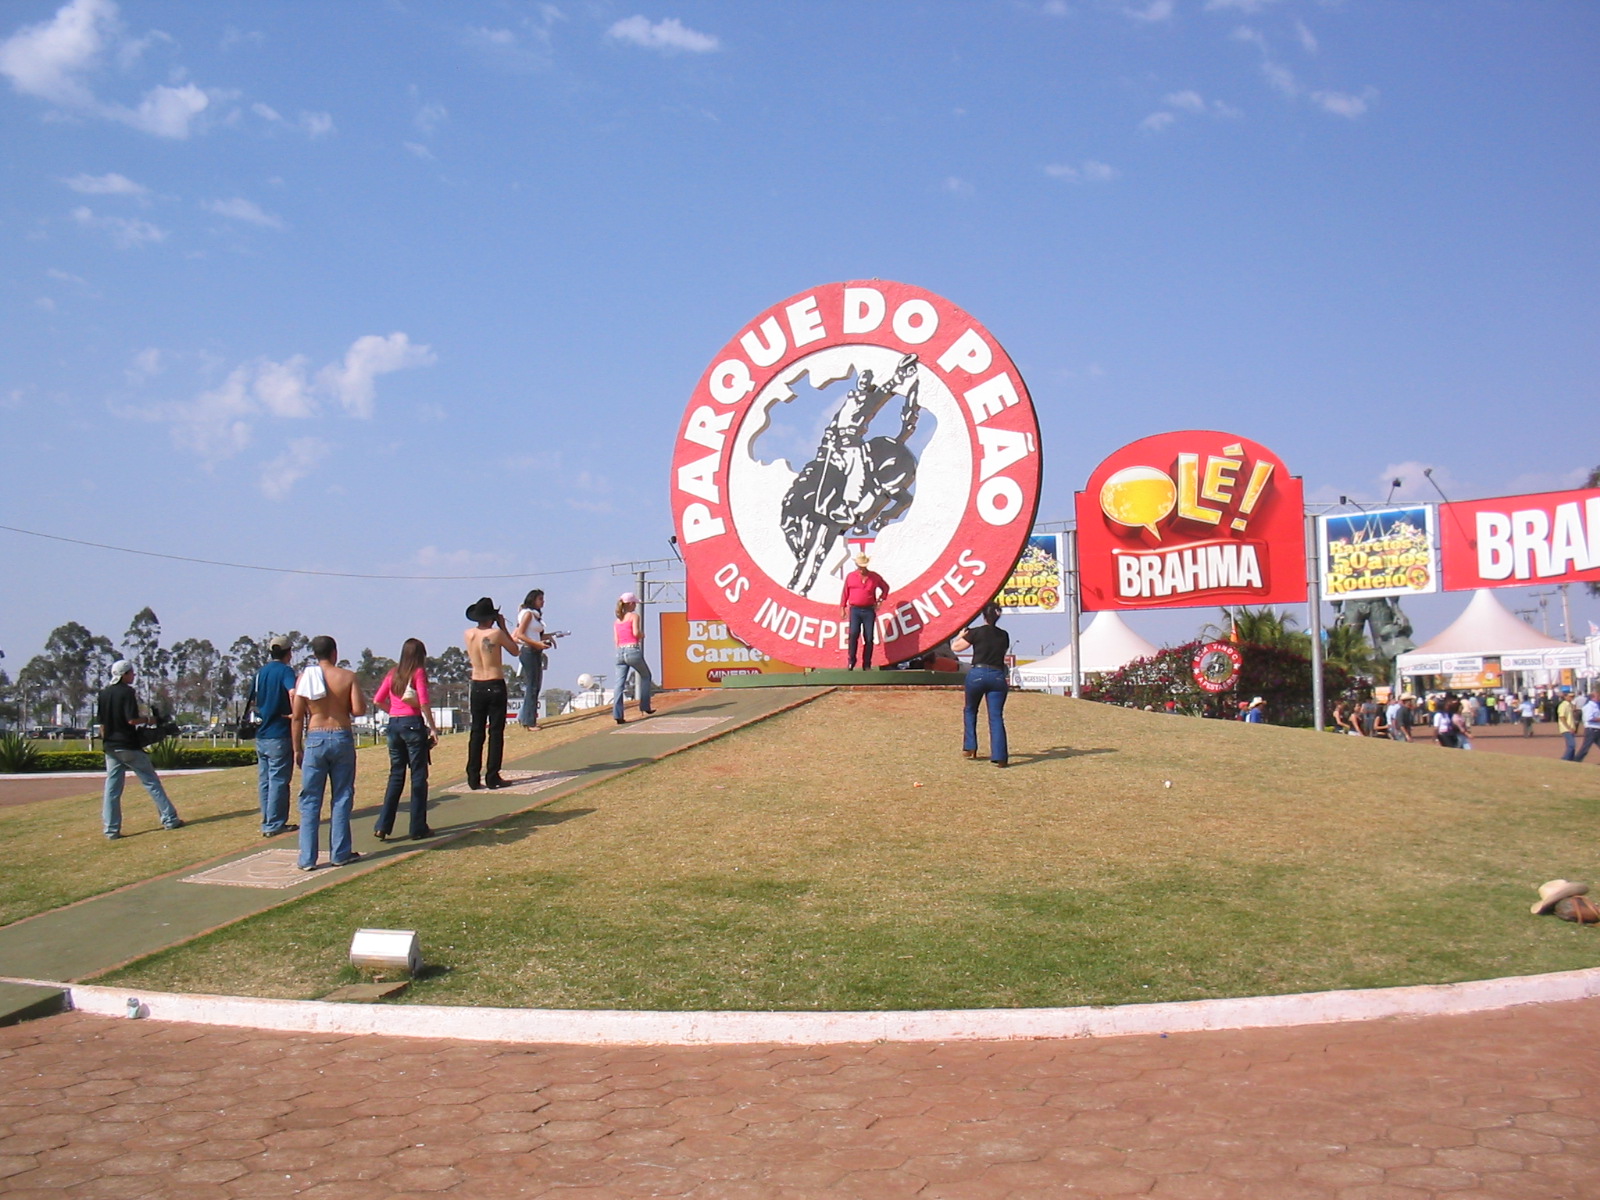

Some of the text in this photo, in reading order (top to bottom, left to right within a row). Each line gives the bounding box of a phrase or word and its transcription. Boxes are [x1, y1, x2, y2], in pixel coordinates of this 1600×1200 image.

[678, 287, 1036, 545] PARQUE DO PEÃO
[1329, 538, 1412, 556] Barretos
[1117, 543, 1264, 599] BRAHMA
[714, 563, 749, 604] OS
[1326, 569, 1407, 595] Rodeio
[994, 589, 1038, 607] deio
[687, 620, 728, 641] Eu
[686, 643, 770, 663] Carne.
[1057, 675, 1073, 683] INGRE
